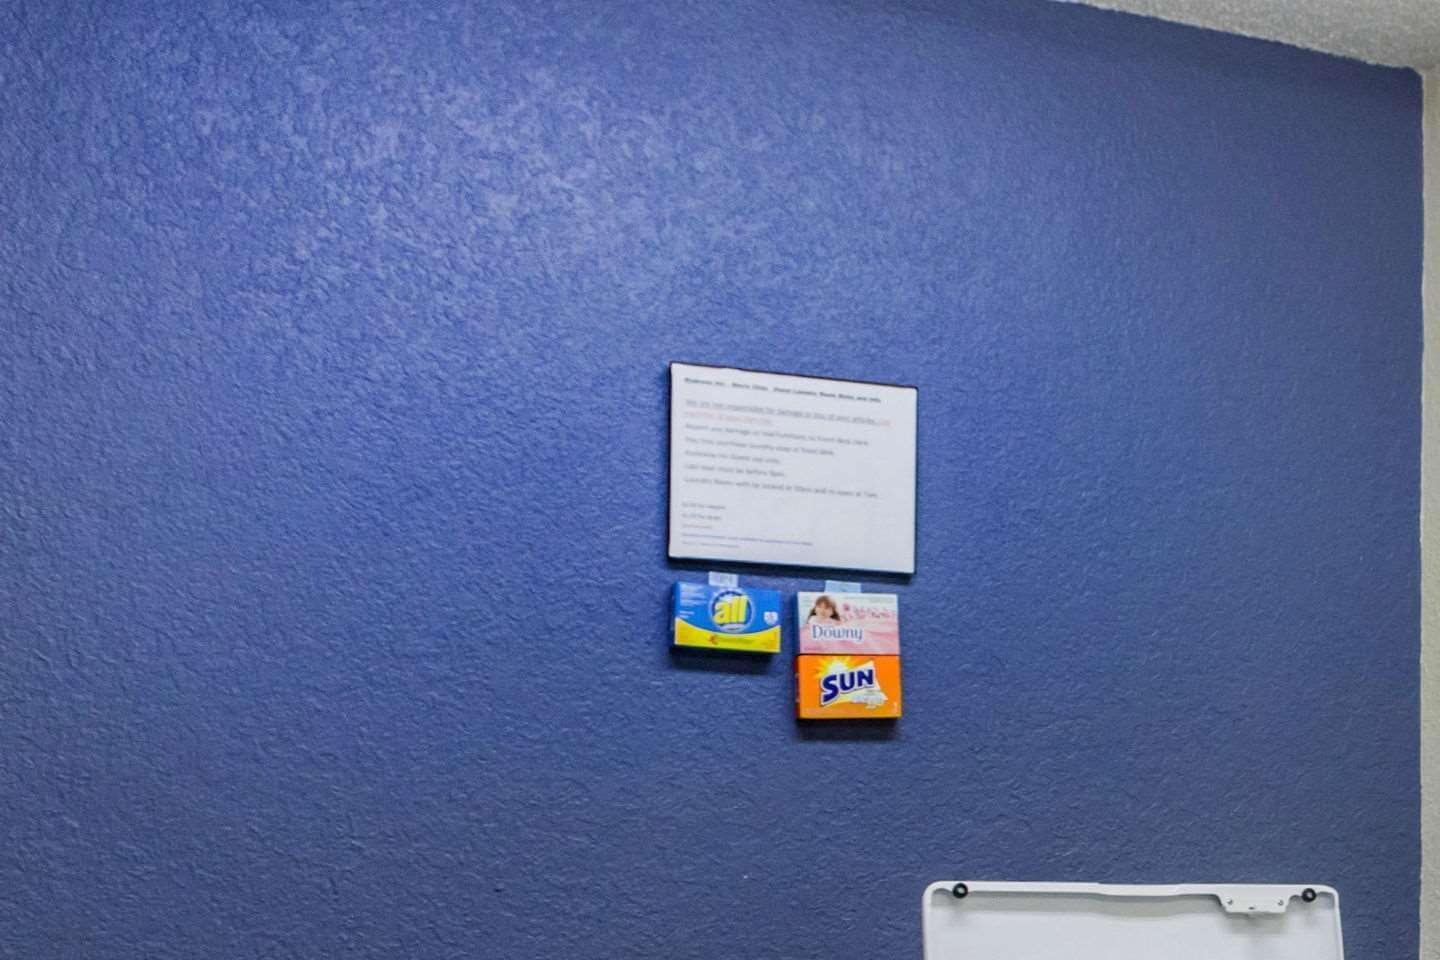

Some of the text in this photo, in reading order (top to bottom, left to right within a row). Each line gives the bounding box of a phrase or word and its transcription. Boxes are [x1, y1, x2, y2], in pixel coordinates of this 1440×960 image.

[714, 595, 748, 624] all
[812, 625, 863, 640] Downy
[823, 669, 874, 702] SUN
